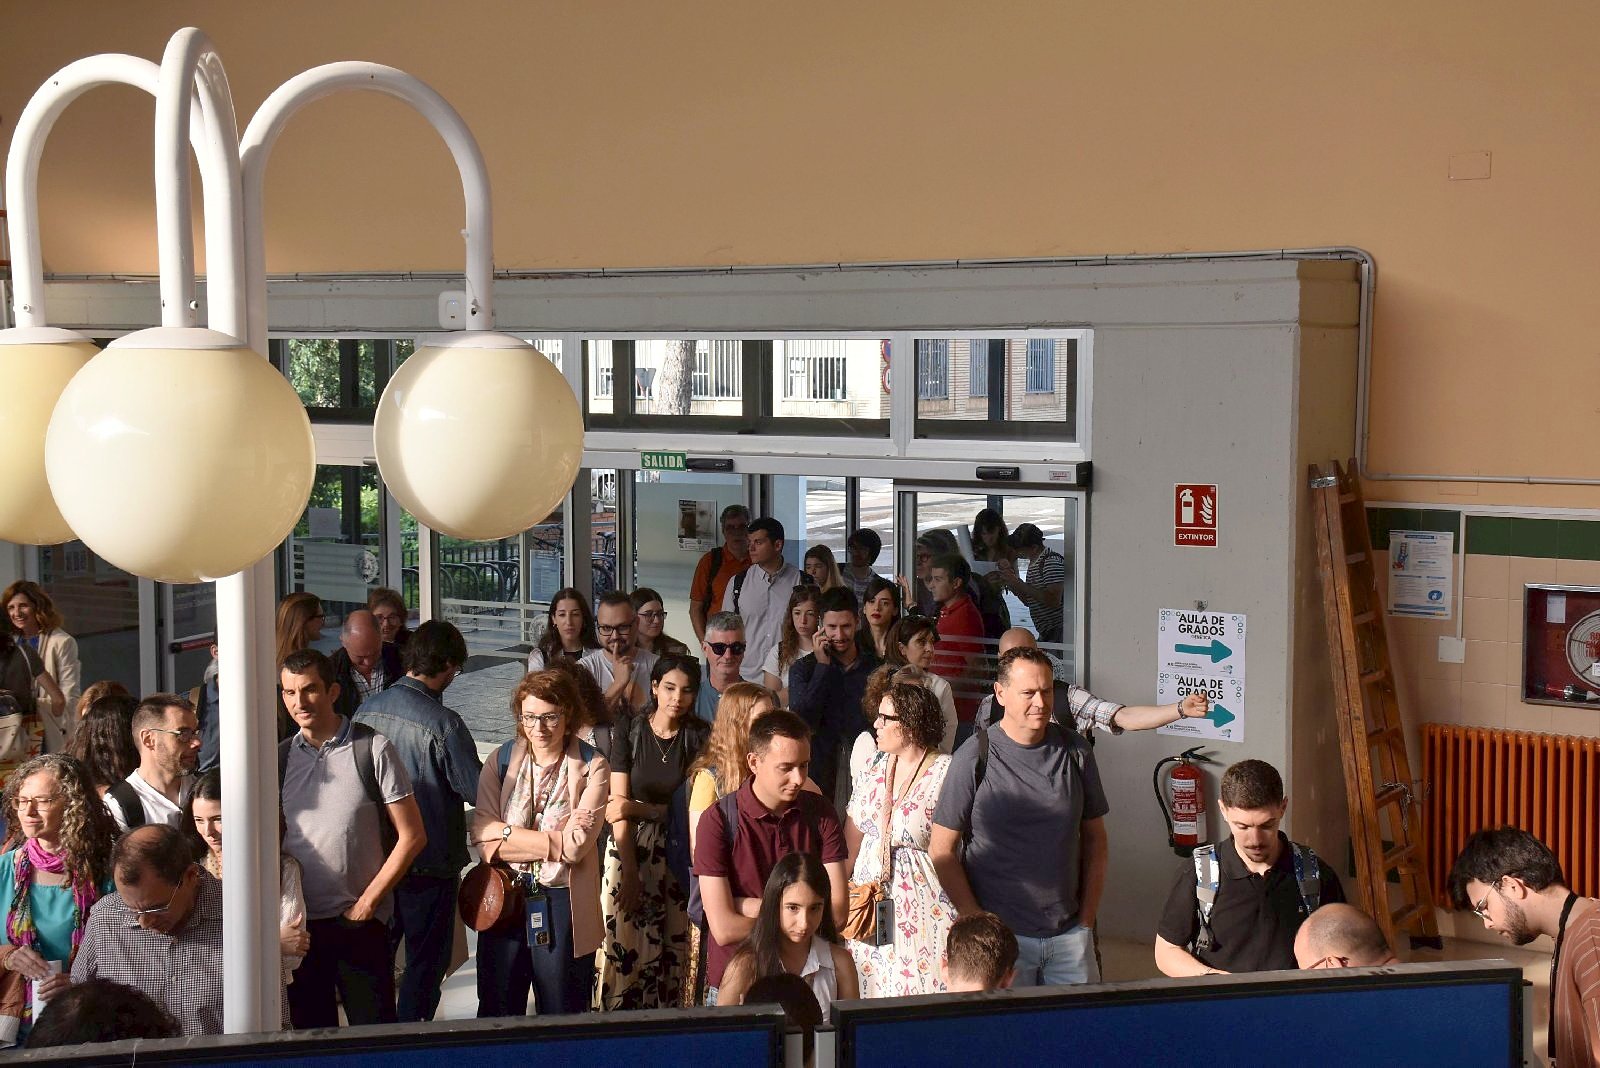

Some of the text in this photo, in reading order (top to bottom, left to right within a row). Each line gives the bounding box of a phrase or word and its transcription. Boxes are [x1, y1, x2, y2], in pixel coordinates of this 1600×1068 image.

[644, 454, 684, 468] SALIDA
[1178, 533, 1214, 541] EXTINTOR
[1179, 613, 1225, 626] AULA DE
[1178, 623, 1225, 636] GRADOS
[1178, 676, 1224, 690] AULA DE
